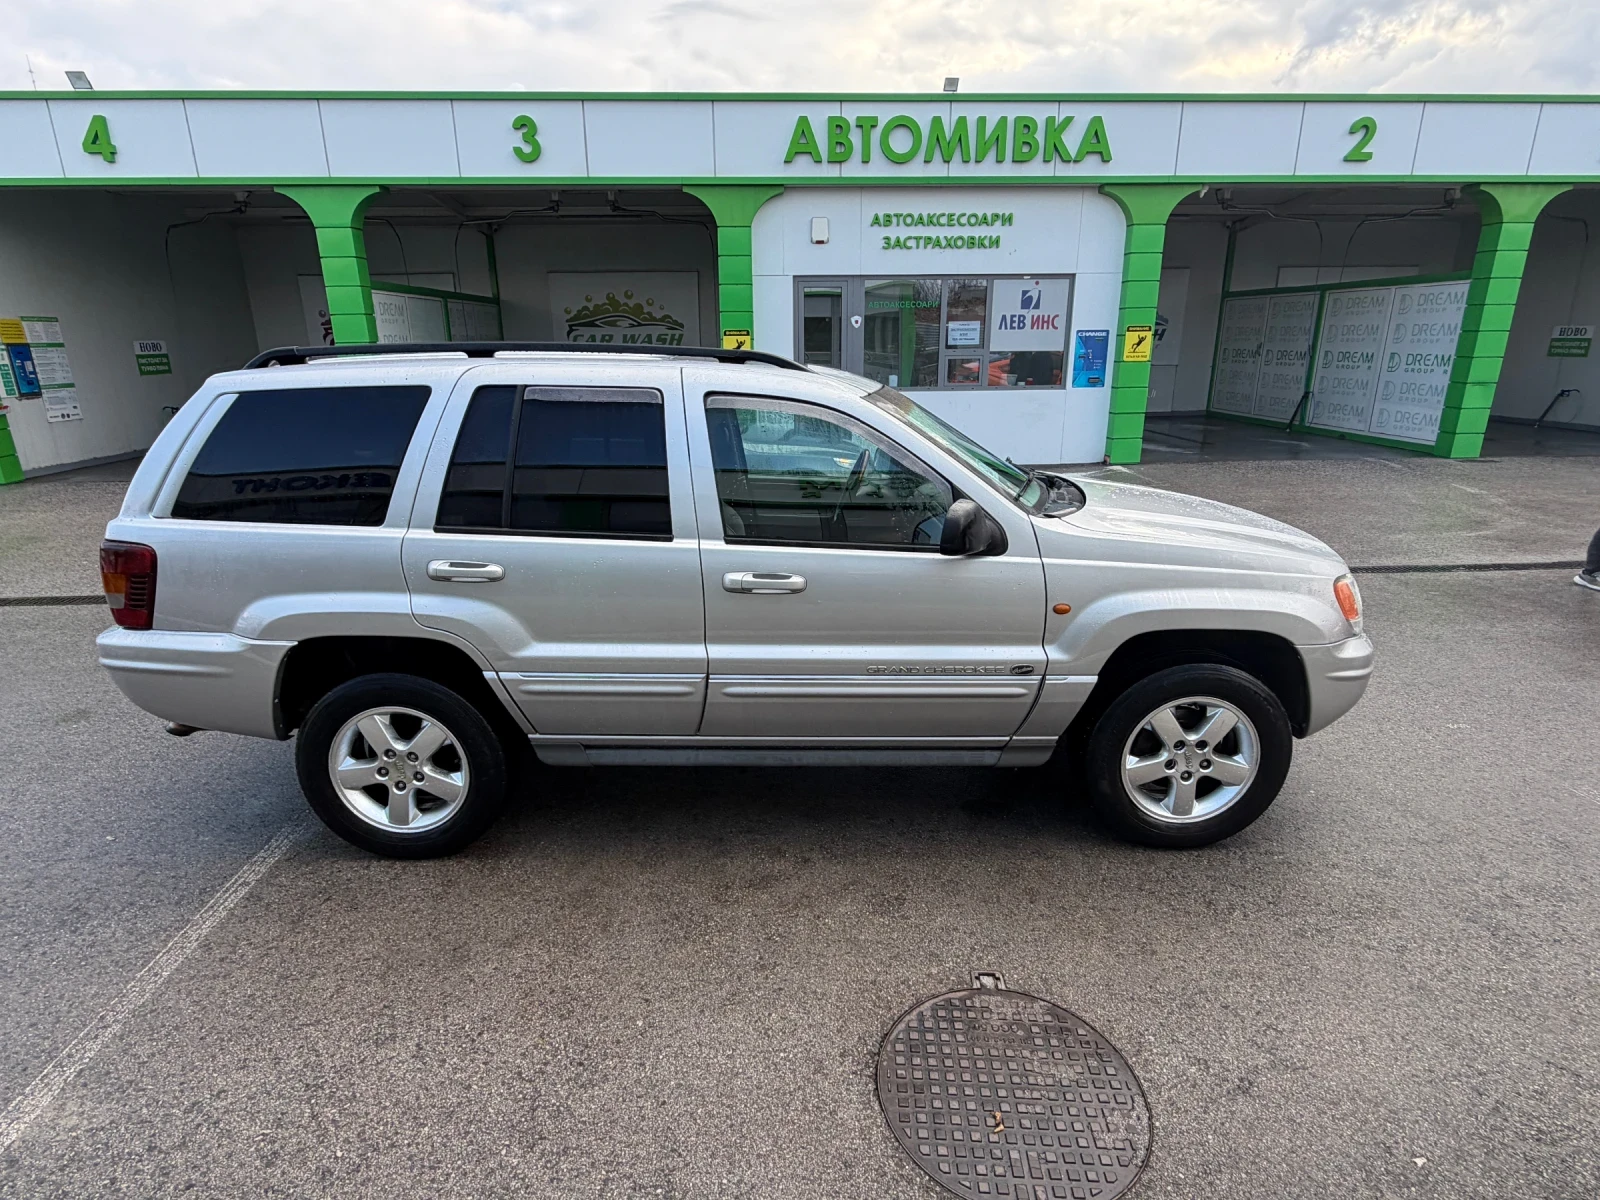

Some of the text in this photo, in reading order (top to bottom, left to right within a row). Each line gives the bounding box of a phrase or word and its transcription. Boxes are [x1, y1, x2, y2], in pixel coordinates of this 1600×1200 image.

[82, 114, 117, 164] 4
[512, 114, 542, 163] 3
[784, 115, 1113, 163] АВТОМИВКА
[1343, 116, 1377, 162] 2
[871, 212, 1014, 227] АВТОАКСЕСОАРИ
[882, 235, 1000, 250] ЗАСТРАХОВКИ
[1346, 296, 1385, 309] DREAM
[1417, 291, 1465, 306] DREAM
[379, 302, 405, 317] DREAM
[999, 314, 1059, 330] ЛЕВ ИНС
[1342, 324, 1379, 336] DREAM
[1411, 323, 1459, 337] DREAM
[1558, 327, 1587, 336] НОВО
[139, 342, 162, 352] НОВО
[572, 333, 684, 346] CAR WASH
[1232, 348, 1258, 359] DREAM
[1276, 349, 1307, 361] DREAM
[1337, 351, 1375, 364] DREAM
[1406, 353, 1452, 368] DREAM
[1332, 377, 1369, 391] DREAM
[1400, 382, 1445, 398] DREAM
[1328, 402, 1364, 417] DREAM
[1394, 410, 1439, 427] DREAM
[866, 665, 919, 674] GRAND
[924, 665, 1005, 674] CHEROKEE
